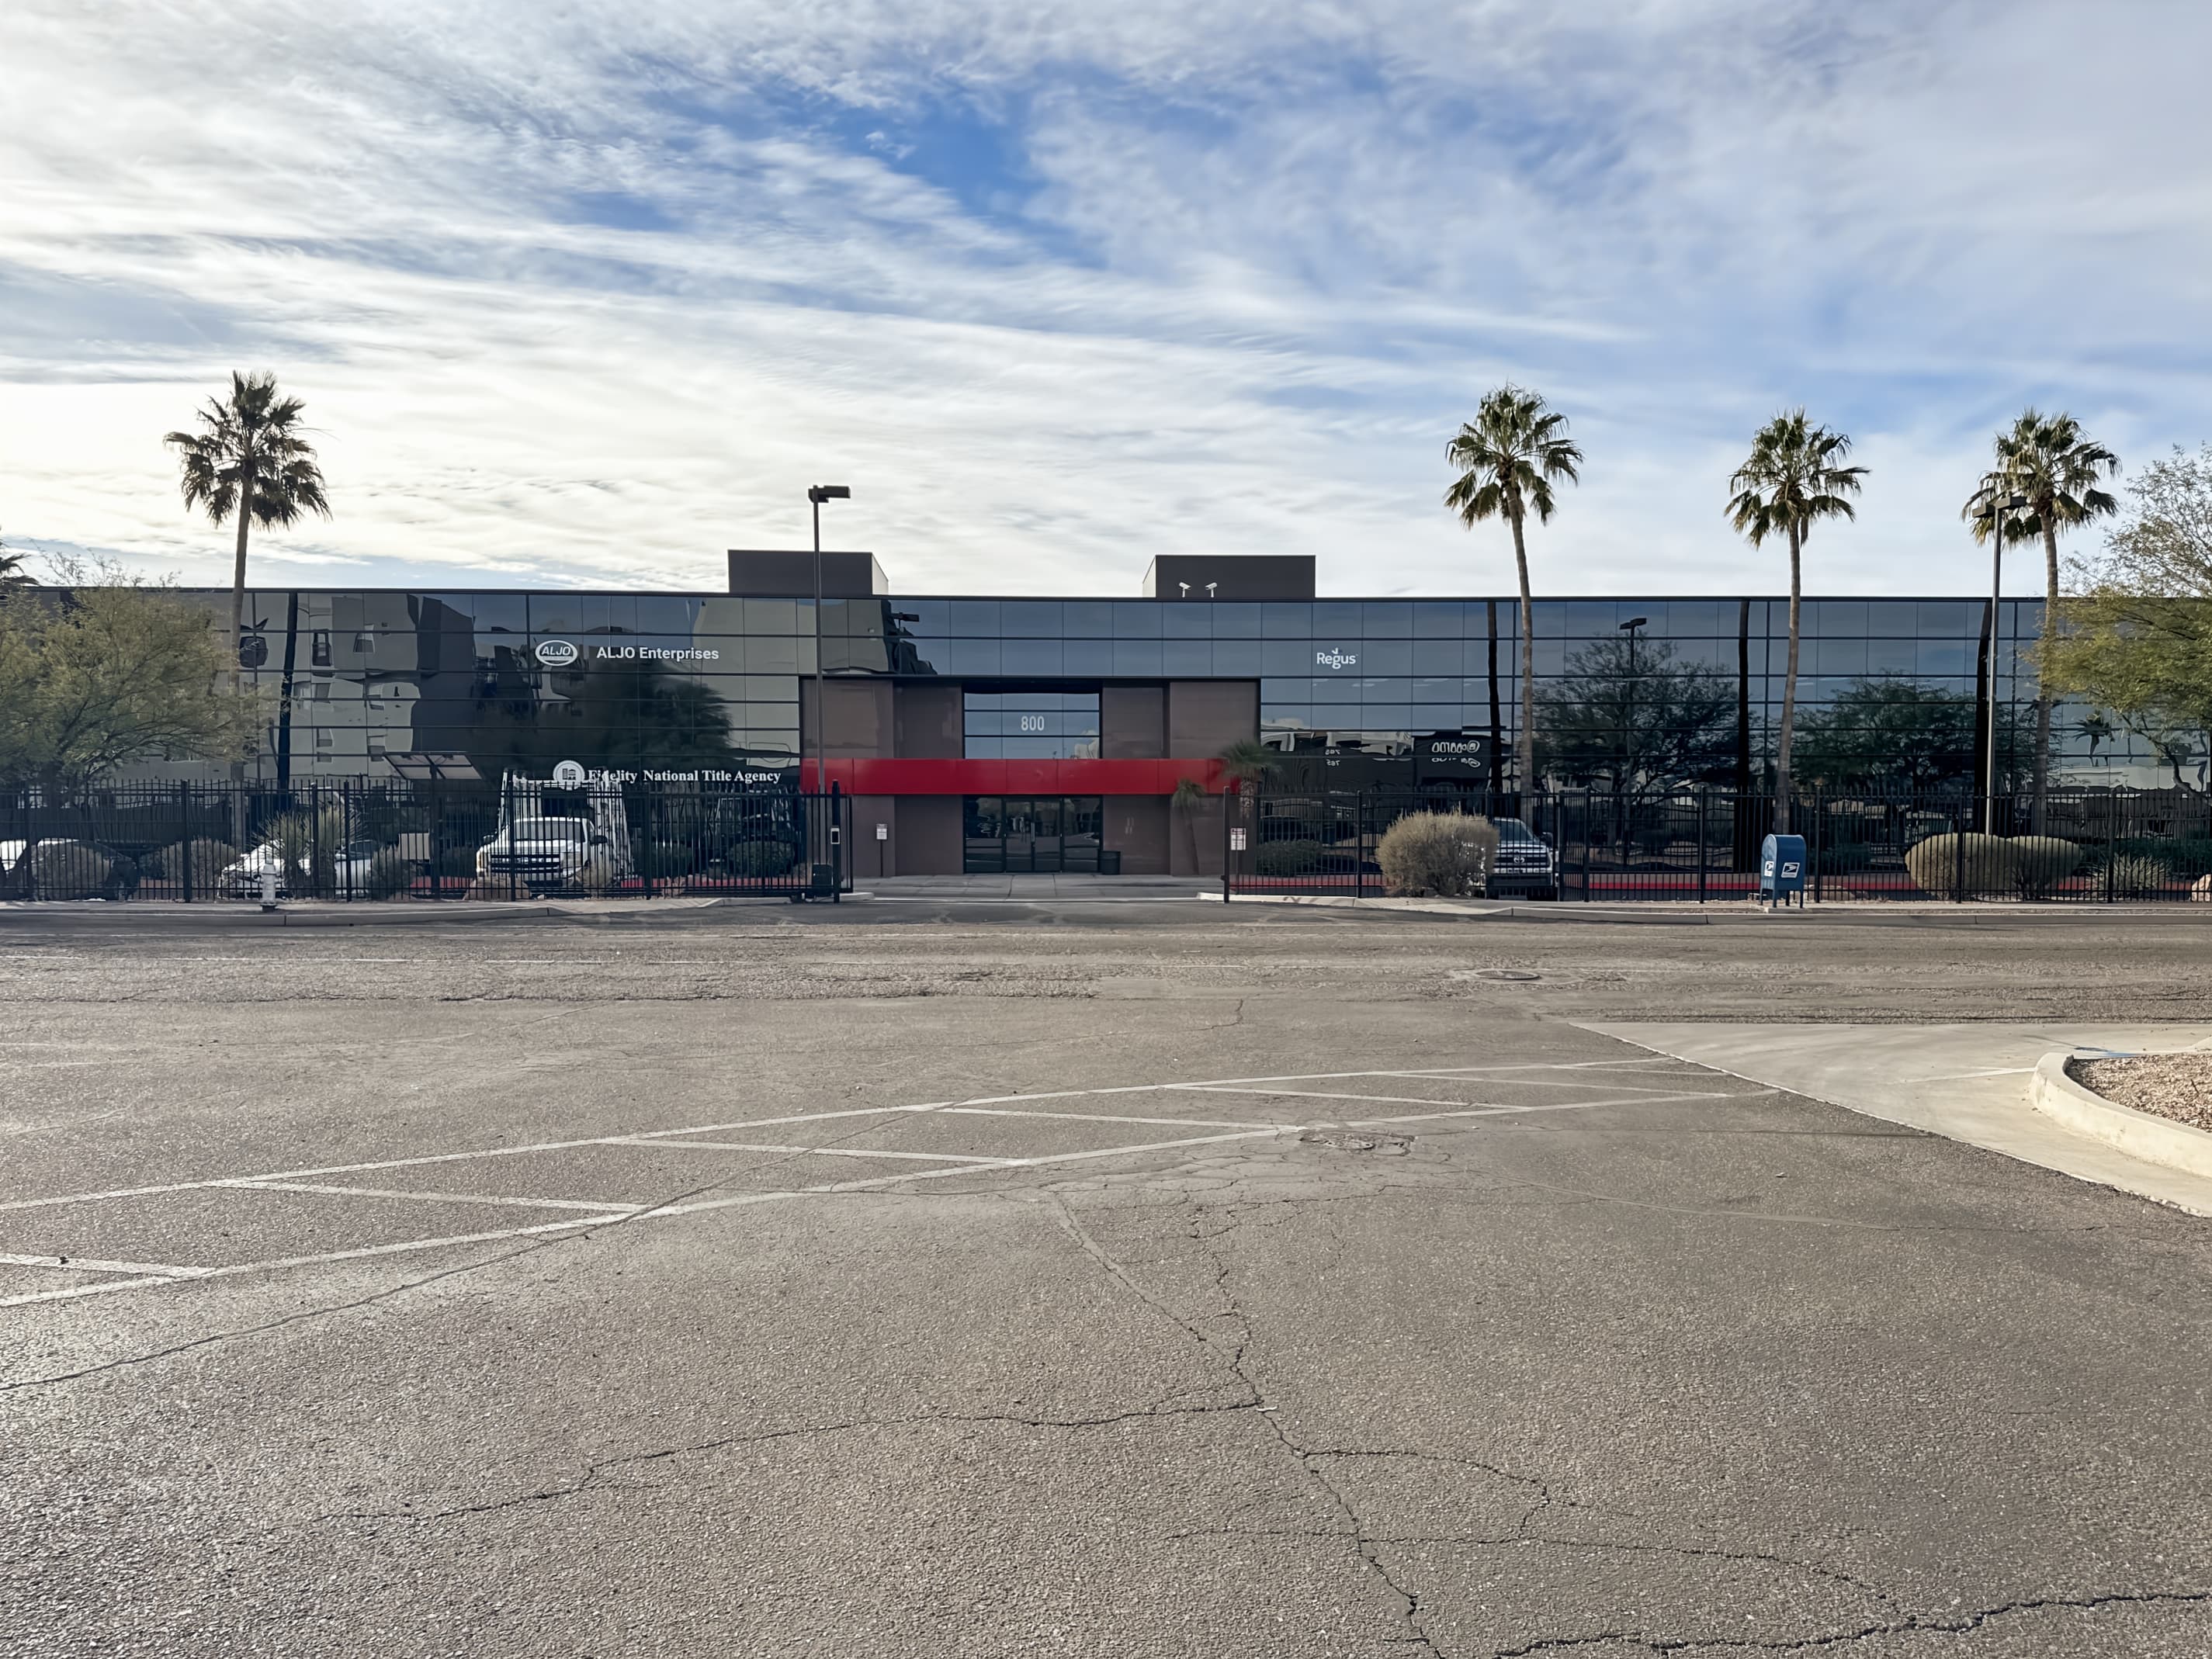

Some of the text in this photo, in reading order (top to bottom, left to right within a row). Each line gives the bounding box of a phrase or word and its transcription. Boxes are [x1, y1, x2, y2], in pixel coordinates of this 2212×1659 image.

[541, 646, 571, 656] ALJO
[596, 646, 719, 662] ALJO Enterprises
[1316, 651, 1357, 670] Regus
[1021, 715, 1045, 731] 800
[588, 770, 781, 784] Fidelity National Title Agency
